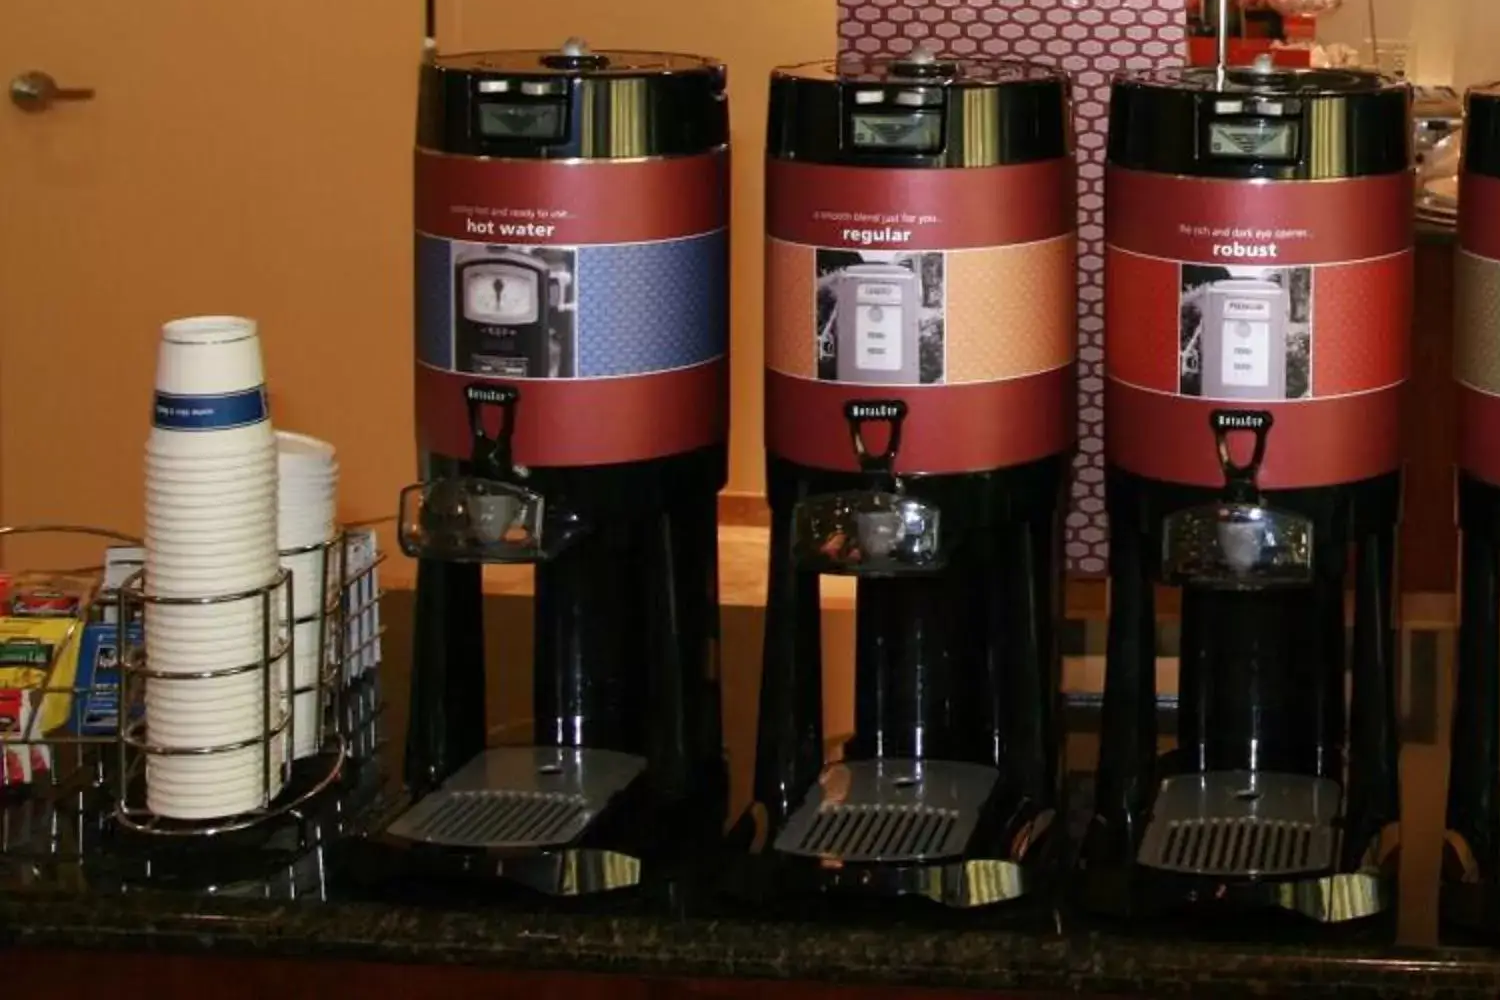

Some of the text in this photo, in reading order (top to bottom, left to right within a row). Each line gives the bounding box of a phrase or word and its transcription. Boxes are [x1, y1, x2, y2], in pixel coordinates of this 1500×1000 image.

[467, 217, 555, 237] hot water
[1212, 227, 1230, 237] and
[843, 227, 911, 245] regular
[1213, 242, 1277, 257] robust
